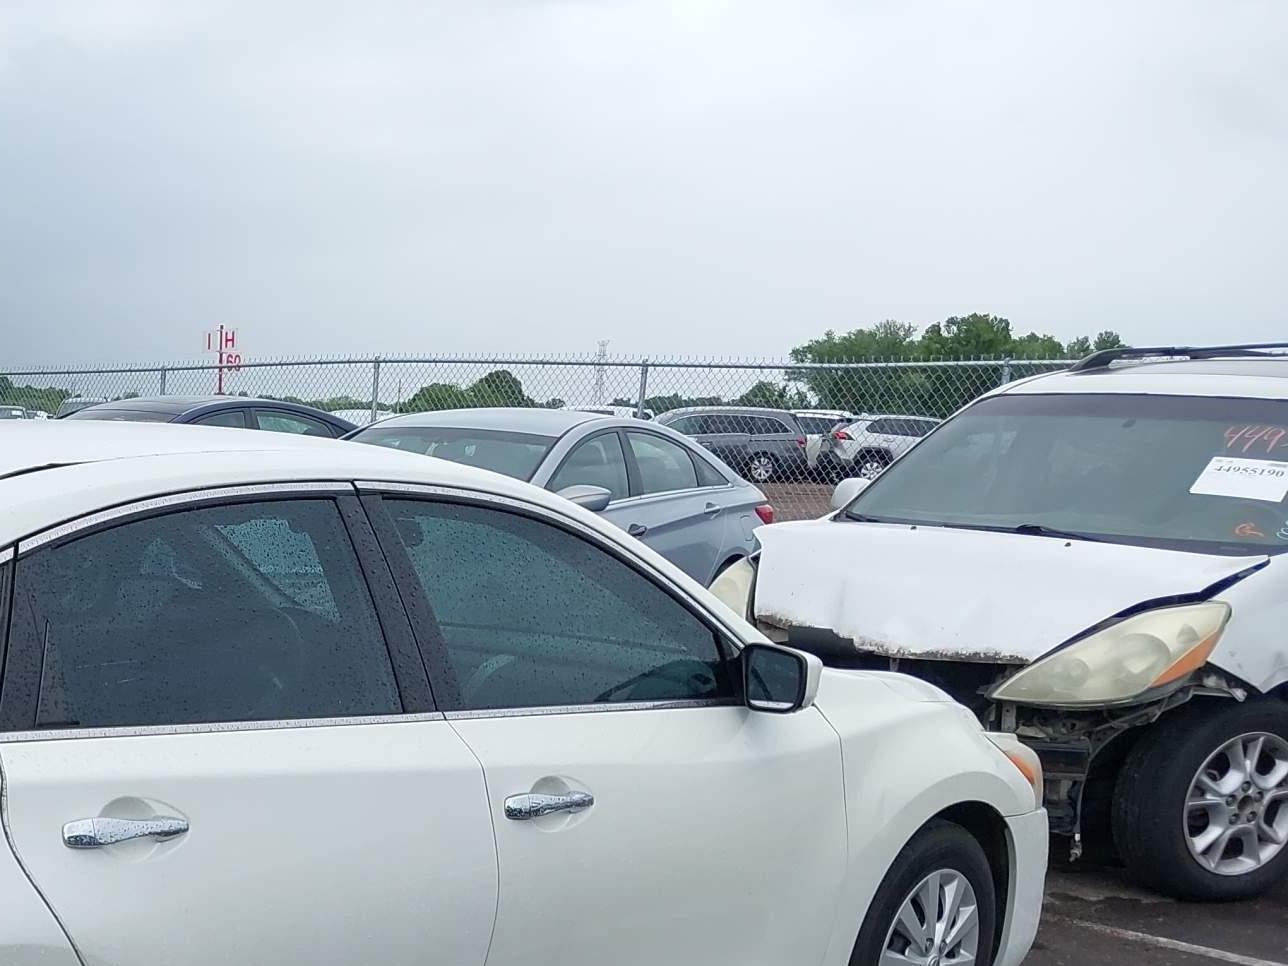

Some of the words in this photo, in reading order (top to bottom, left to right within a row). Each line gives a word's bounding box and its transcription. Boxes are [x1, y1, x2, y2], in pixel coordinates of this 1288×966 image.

[224, 330, 235, 349] H
[226, 353, 242, 372] 60
[1223, 425, 1288, 453] 449
[1214, 465, 1285, 478] 44955190
